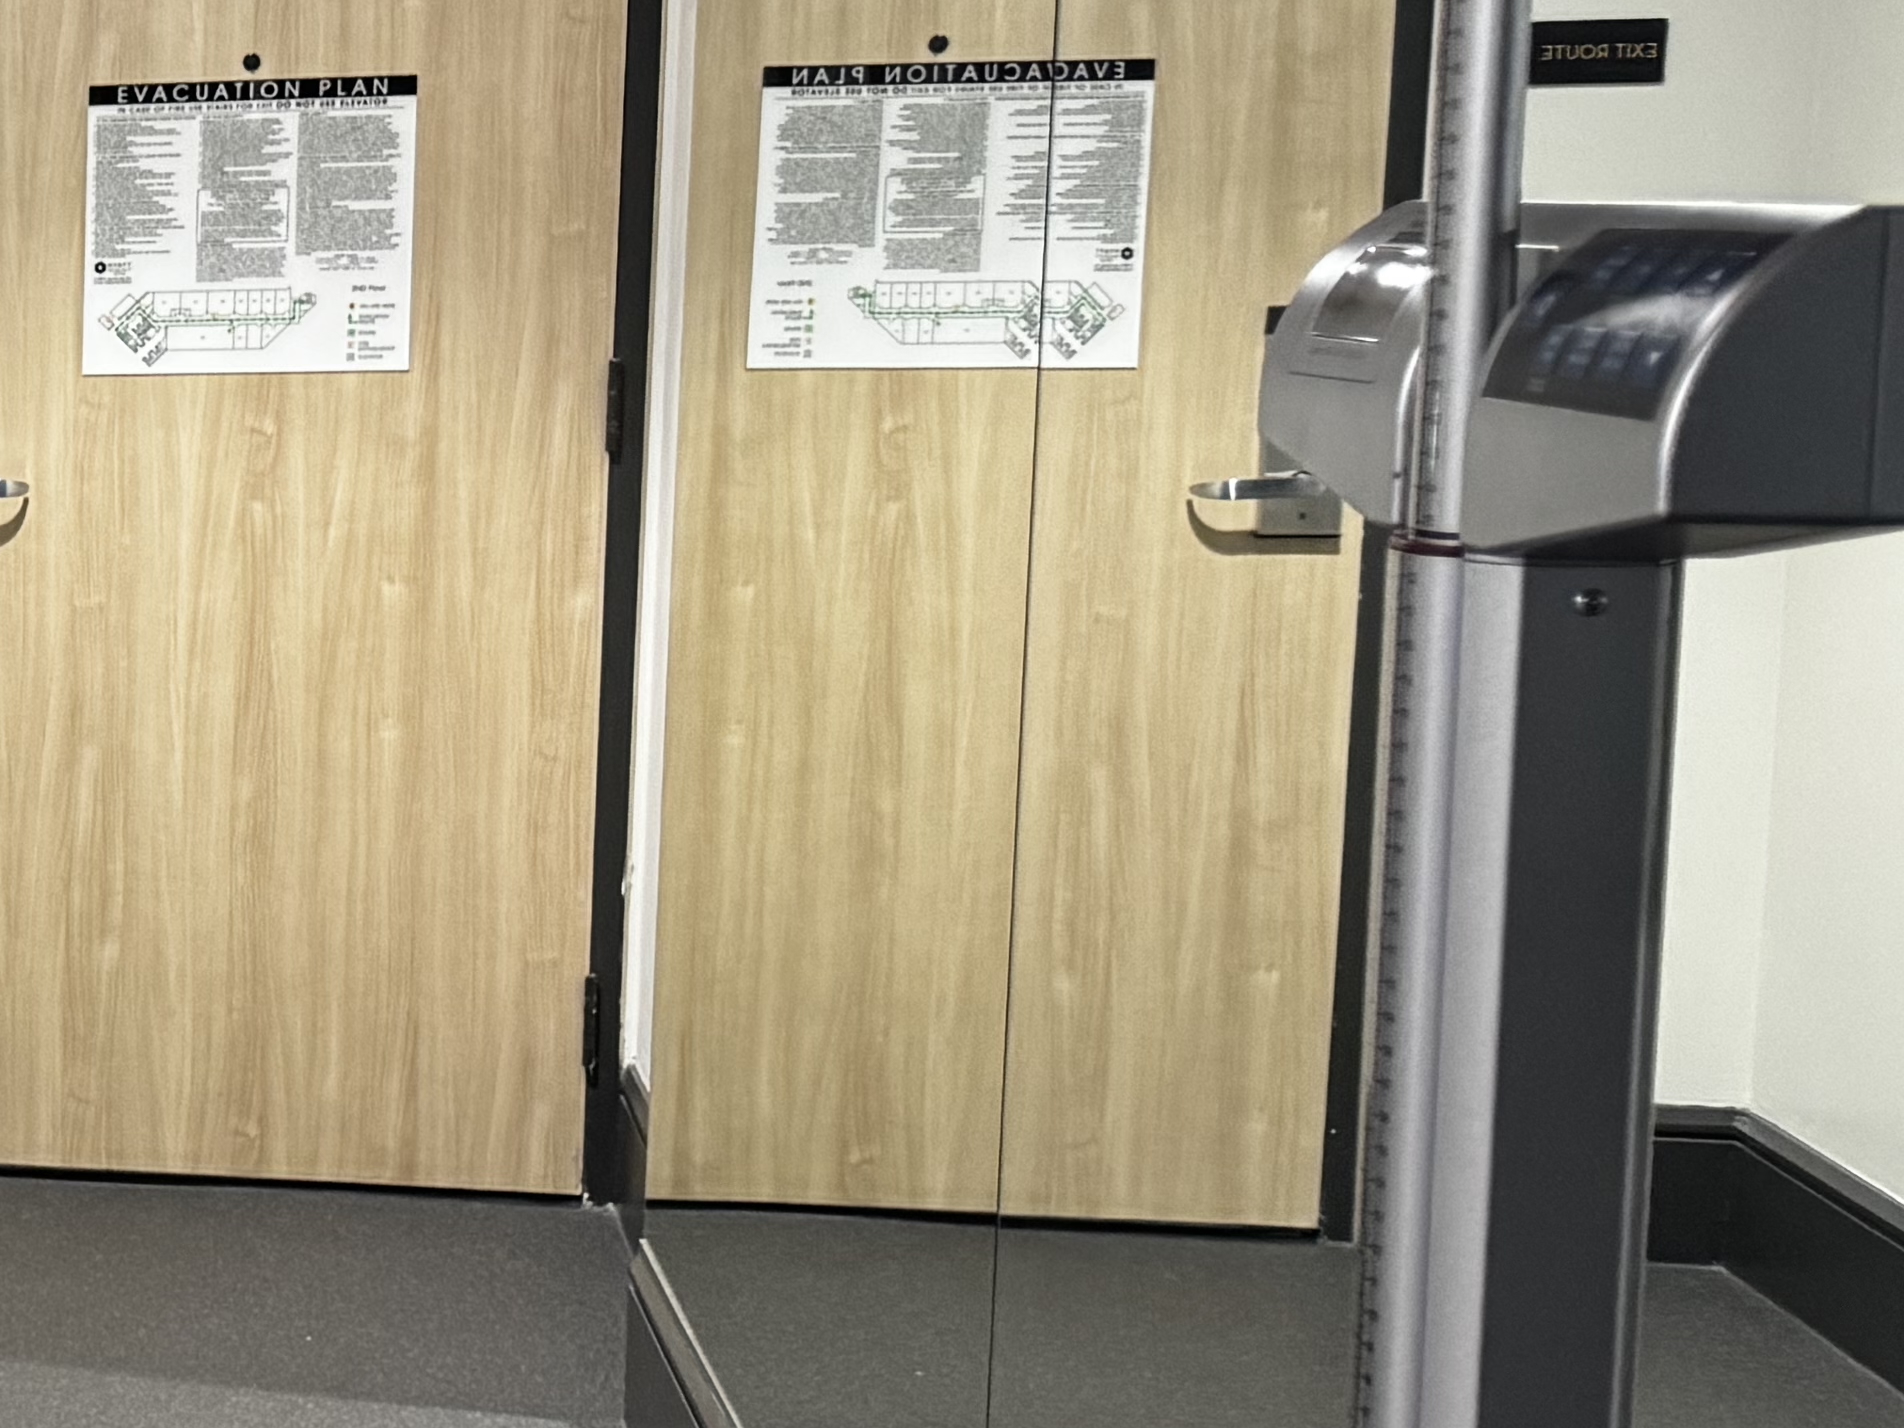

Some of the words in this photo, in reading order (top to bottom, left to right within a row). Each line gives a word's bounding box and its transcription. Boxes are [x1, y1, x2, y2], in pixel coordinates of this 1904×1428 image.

[117, 79, 300, 104] EVACUATION
[318, 77, 389, 97] PLAN
[276, 100, 291, 109] DO
